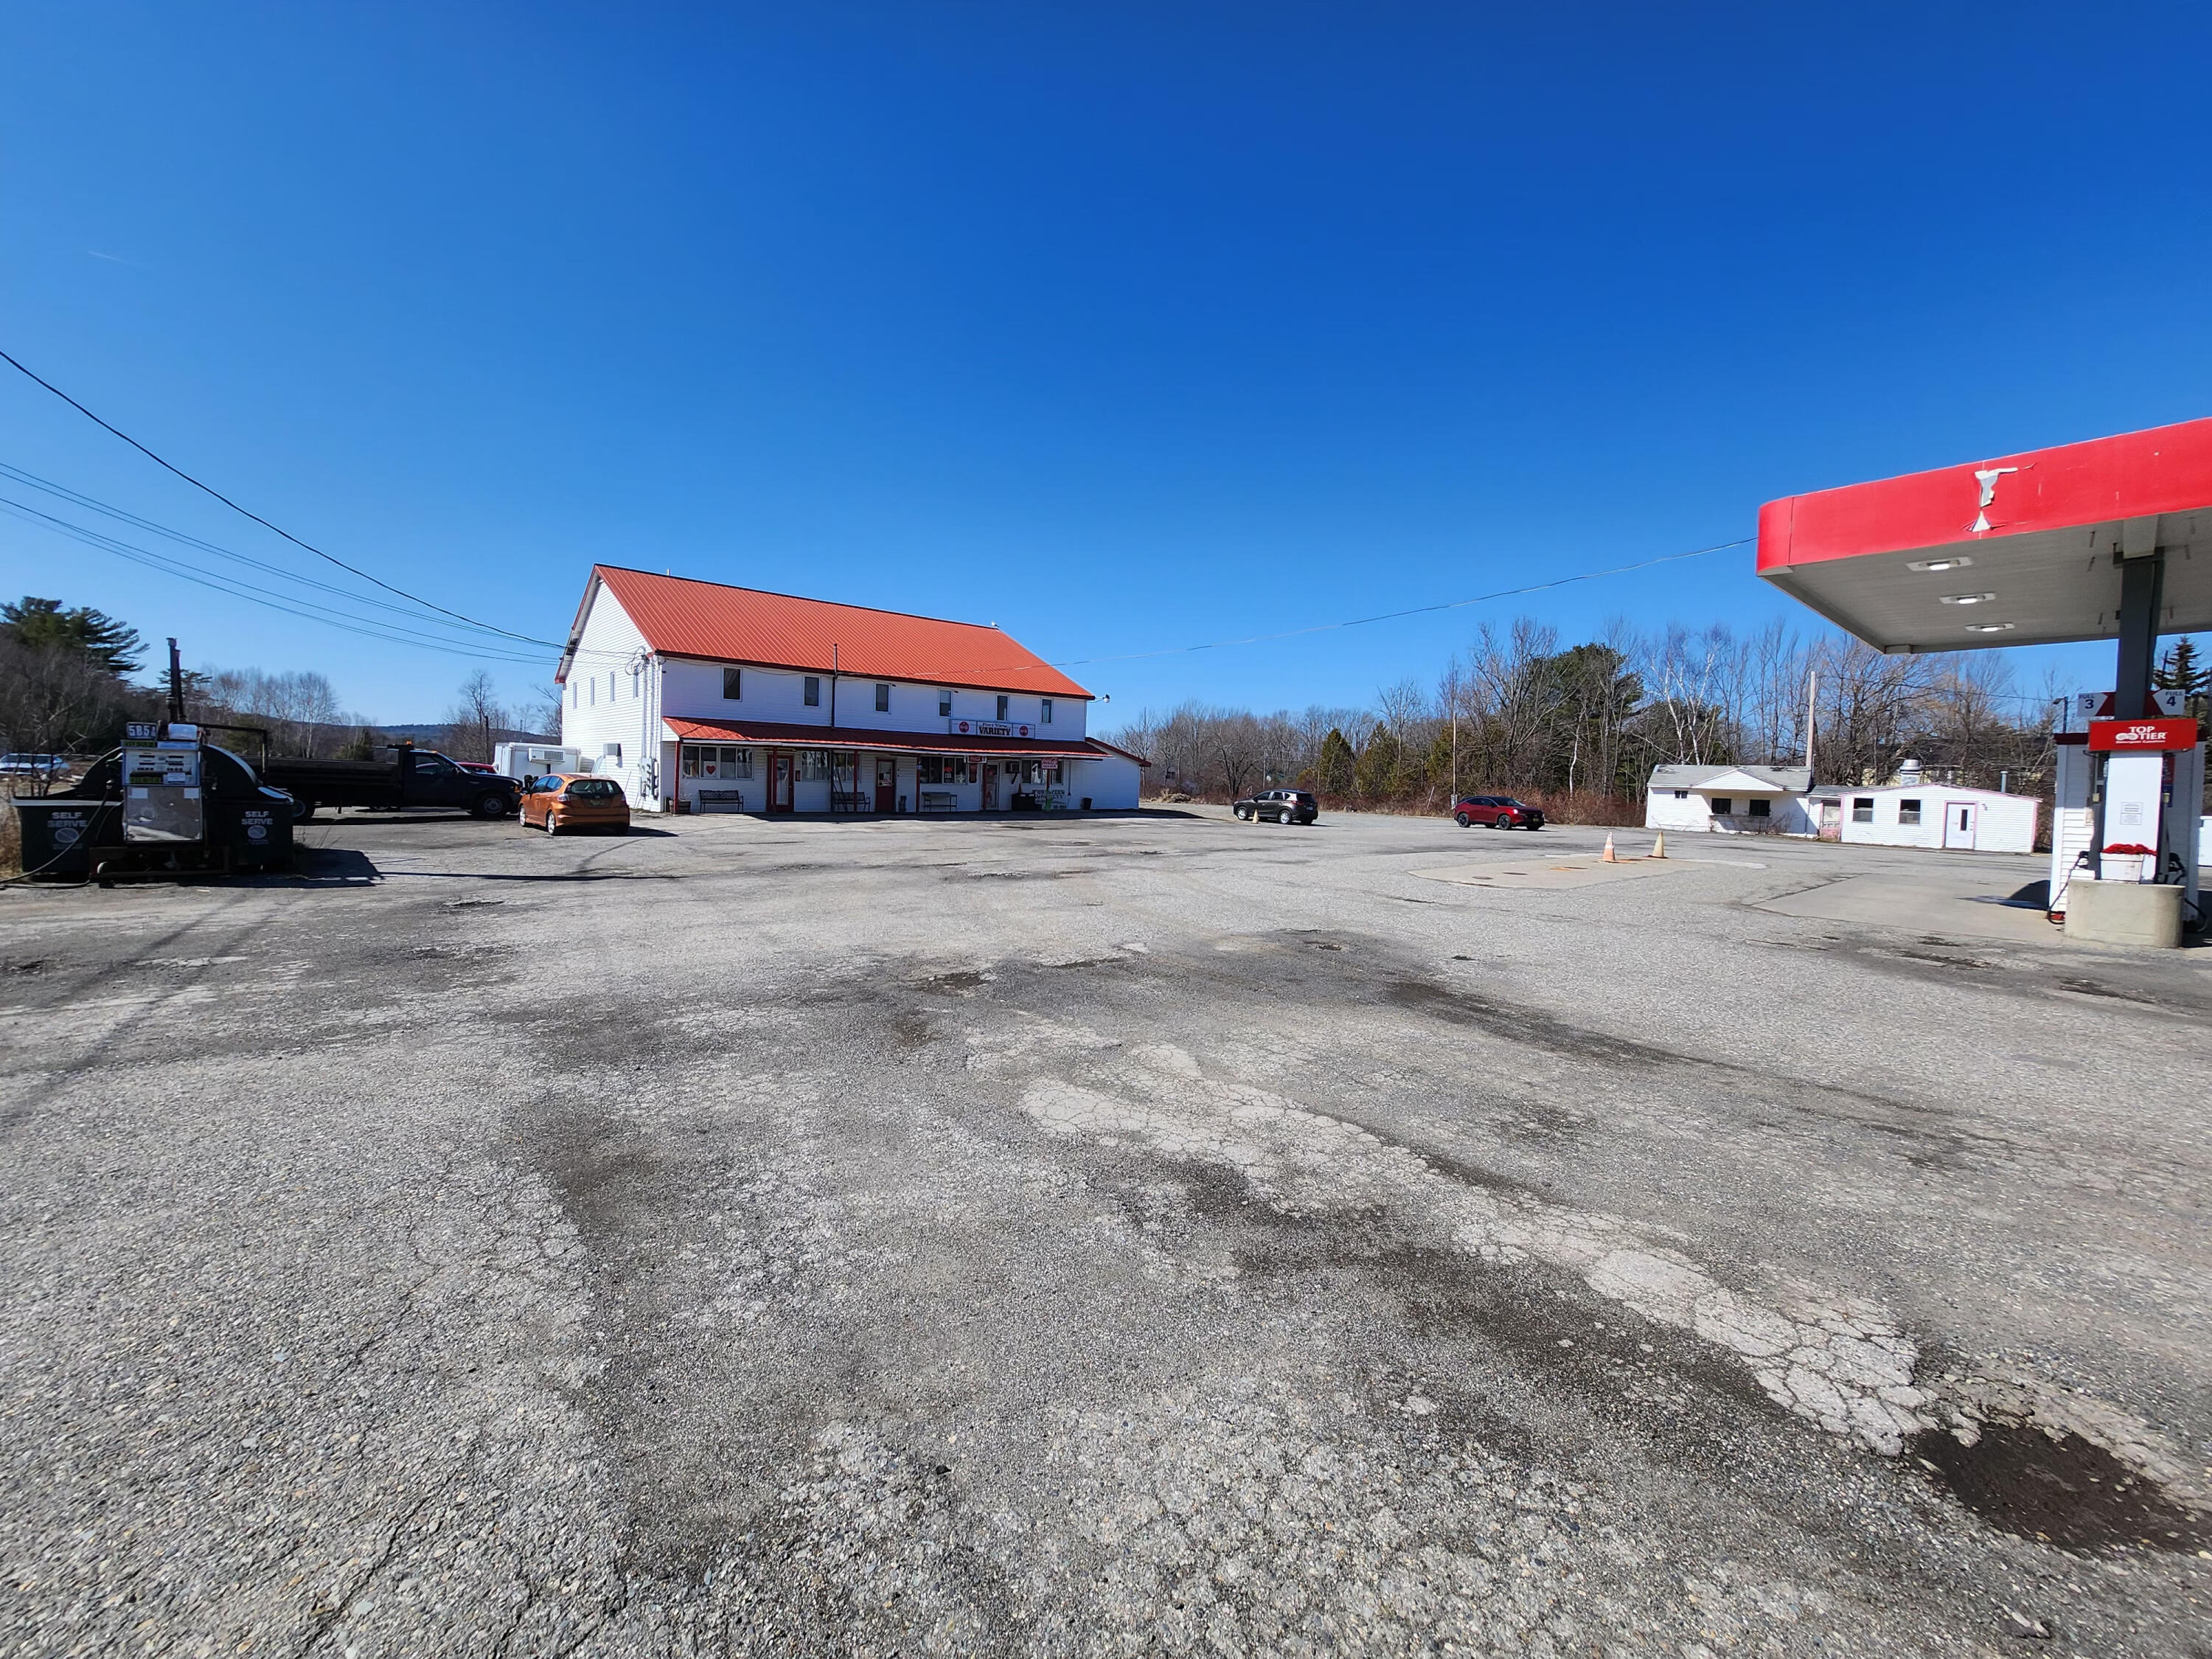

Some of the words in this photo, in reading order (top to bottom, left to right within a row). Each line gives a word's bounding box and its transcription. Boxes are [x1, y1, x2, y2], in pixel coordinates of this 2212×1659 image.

[2084, 699, 2094, 709] 3
[2166, 695, 2177, 706] 4
[978, 726, 1011, 736] VARIETY
